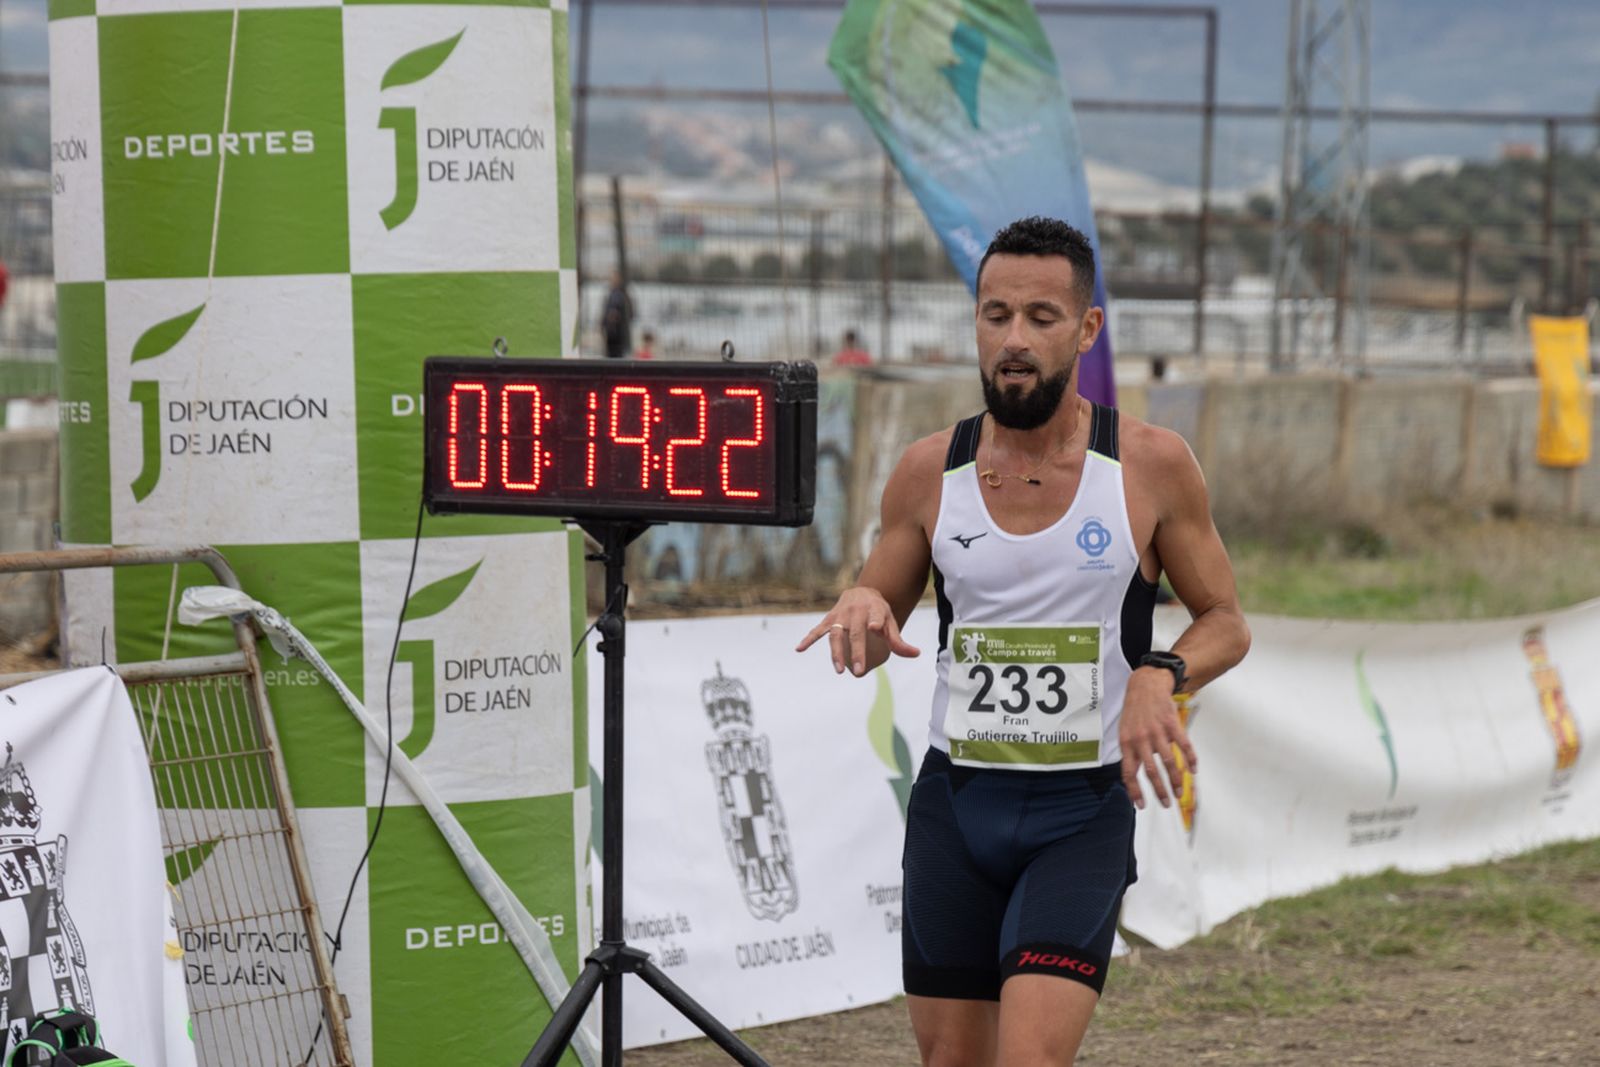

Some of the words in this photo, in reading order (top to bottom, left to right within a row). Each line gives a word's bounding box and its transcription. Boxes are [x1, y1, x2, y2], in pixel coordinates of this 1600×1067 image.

[124, 130, 314, 158] DEPORTES
[427, 123, 544, 150] DIPUTACIÓN
[428, 160, 459, 182] DE
[465, 156, 514, 182] JAÉN
[168, 395, 328, 423] DIPUTACIÓN
[169, 433, 201, 455] DE
[206, 430, 271, 455] JAÉN
[445, 651, 562, 682] DIPUTACIÓN
[987, 649, 1017, 658] Campo
[1028, 648, 1056, 657] través
[445, 690, 477, 714] DE
[481, 683, 531, 713] JAÉN
[968, 665, 1068, 714] 233
[1089, 667, 1098, 711] Veterano
[1003, 715, 1029, 726] Fran
[967, 729, 1028, 743] Gutierrez
[1031, 731, 1078, 746] Trujillo
[406, 914, 564, 949] DEPOES
[186, 964, 216, 985] DE
[221, 961, 286, 986] JAÉN
[1017, 951, 1097, 977] HOKO
